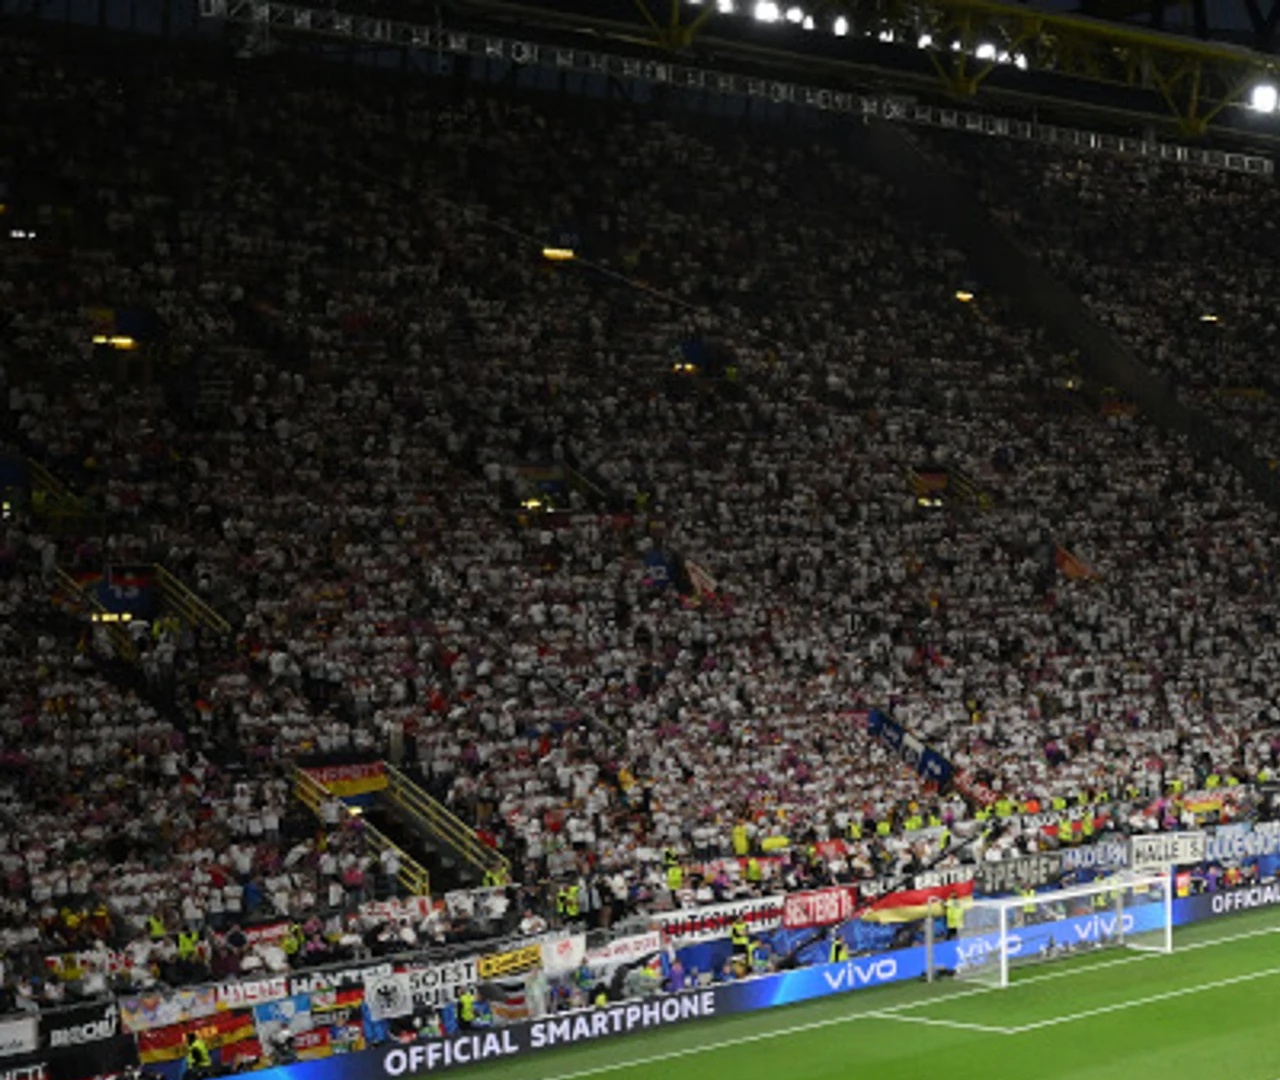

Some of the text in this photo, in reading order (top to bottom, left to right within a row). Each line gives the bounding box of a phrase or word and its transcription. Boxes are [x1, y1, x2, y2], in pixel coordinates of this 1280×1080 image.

[824, 957, 898, 990] vivo
[384, 990, 716, 1078] OFFICIAL SMARTPHONE
